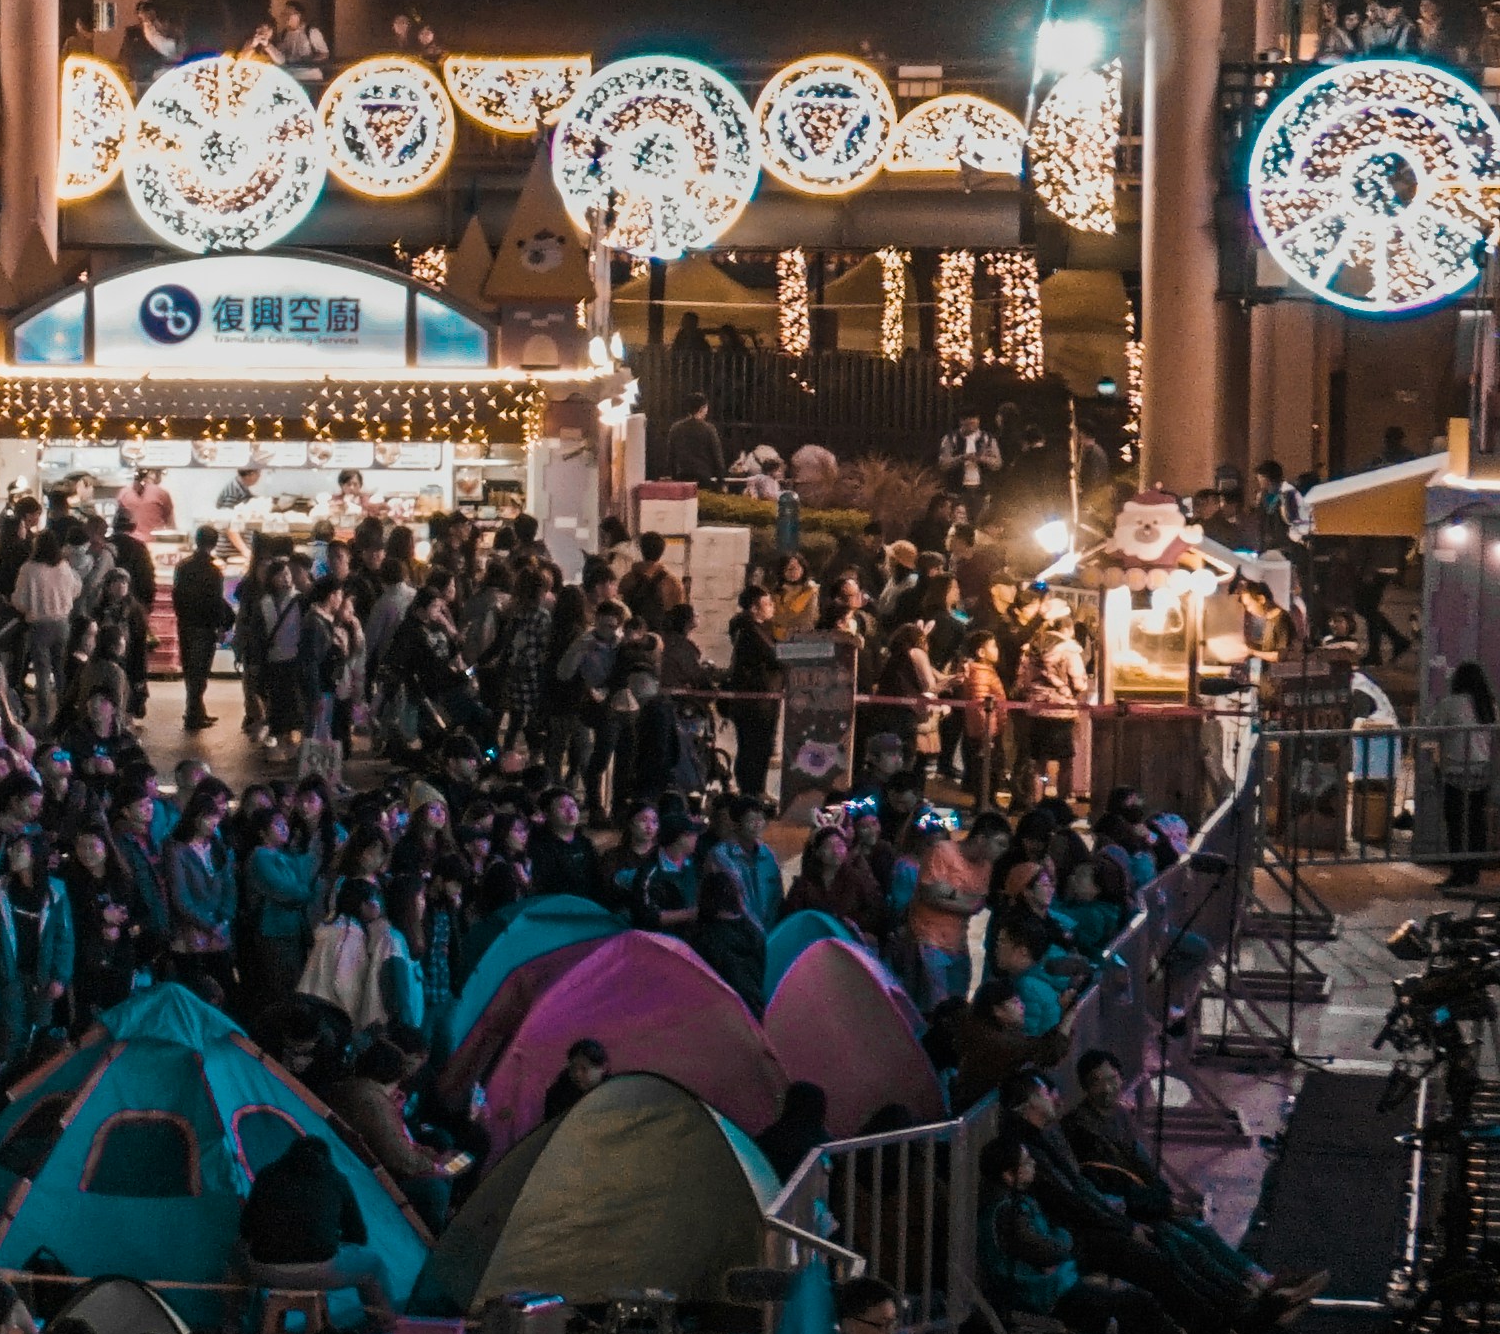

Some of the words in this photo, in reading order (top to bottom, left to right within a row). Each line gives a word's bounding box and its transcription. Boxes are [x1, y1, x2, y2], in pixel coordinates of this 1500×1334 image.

[212, 295, 361, 334] 復興空廚
[268, 335, 313, 346] Catering
[317, 335, 359, 345] Services
